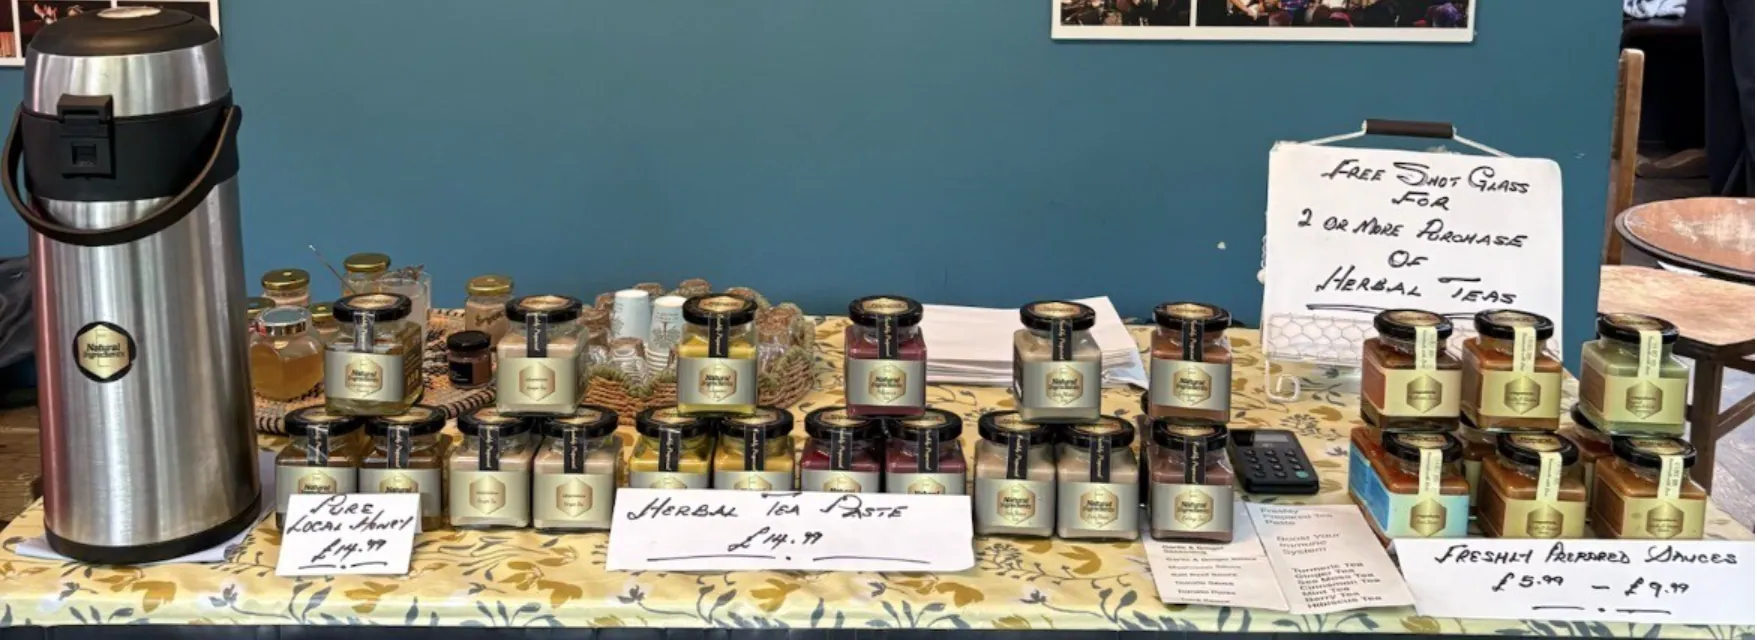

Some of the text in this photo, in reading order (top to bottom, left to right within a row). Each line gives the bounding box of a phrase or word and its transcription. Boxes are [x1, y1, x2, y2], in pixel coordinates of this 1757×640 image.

[1321, 159, 1530, 194] FREE SHOT GLASS
[1391, 191, 1450, 211] FOR
[1298, 208, 1528, 248] 2 OR MORE PURCHASE
[1388, 250, 1428, 268] OF
[1315, 265, 1517, 304] HERBAL TEAS
[84, 351, 124, 359] Ingredients
[87, 343, 120, 352] Natural
[1180, 378, 1206, 386] Natural
[310, 495, 374, 515] PURE
[627, 492, 909, 519] HERBAL TEA PASTE
[286, 510, 414, 534] LOCAL HONEY
[727, 526, 823, 551] £14.99
[311, 538, 387, 562] £14.99
[1282, 547, 1327, 555] System
[1434, 541, 1738, 565] FRESHLY PREPARED SAUCES
[1292, 564, 1340, 573] Turmeric
[1294, 571, 1332, 579] Ginger
[1300, 581, 1358, 590] Cinnamon
